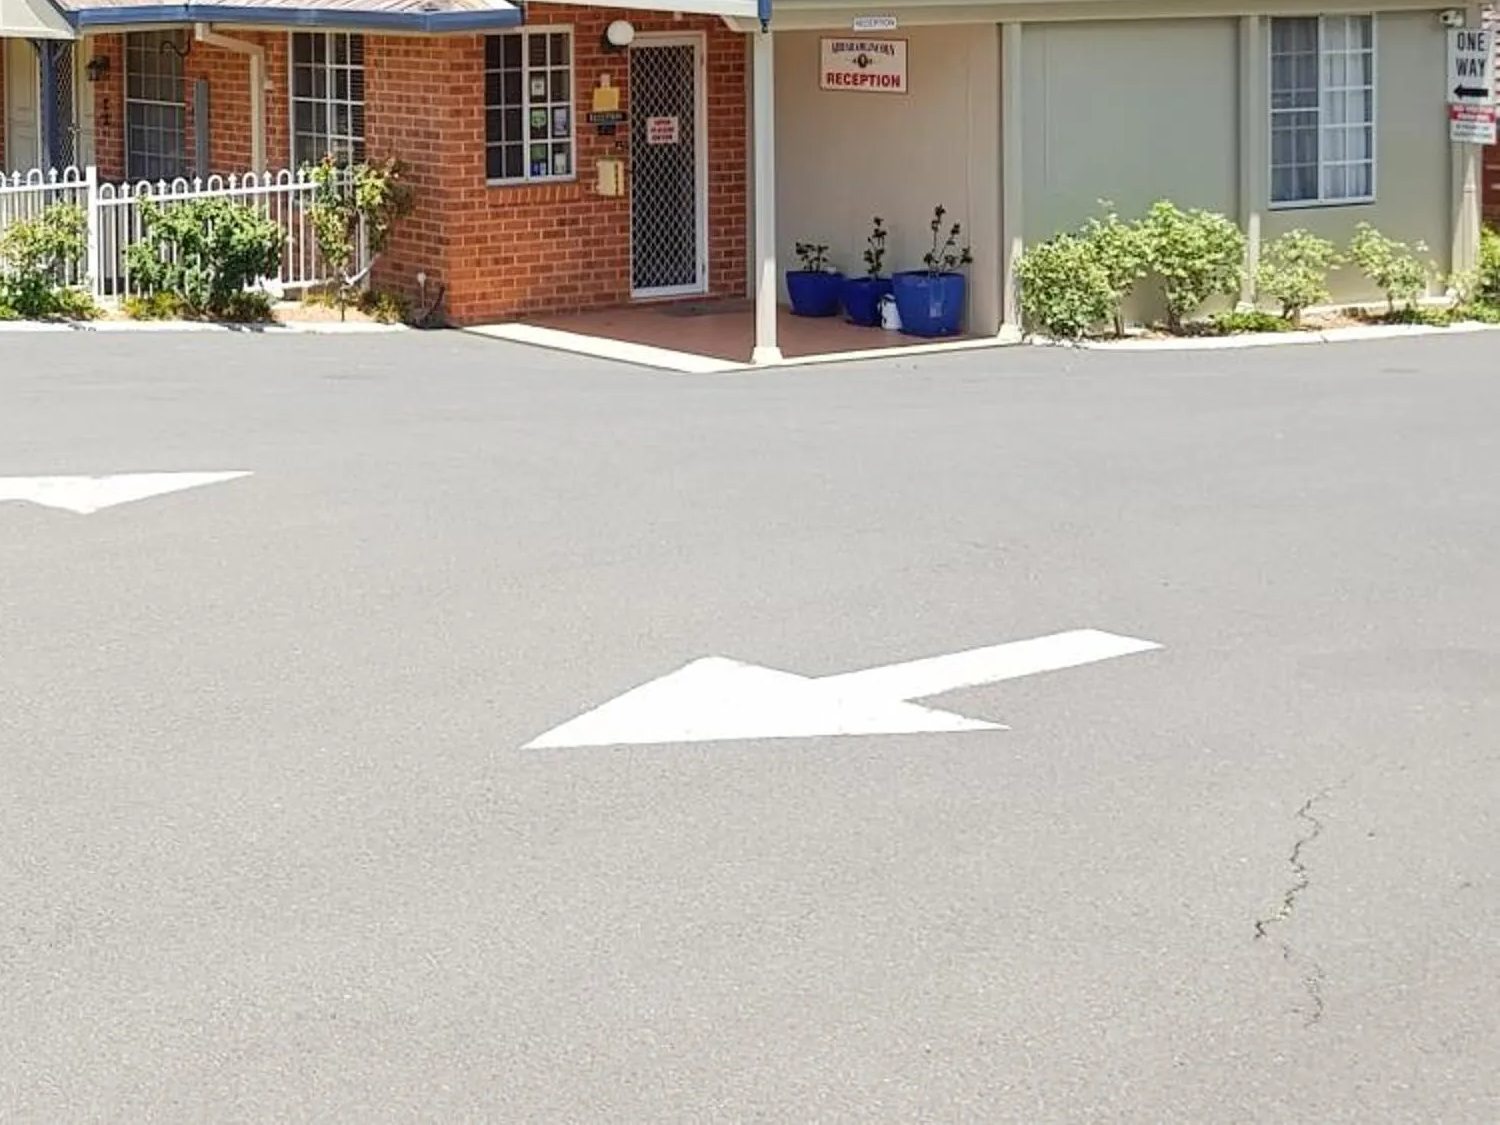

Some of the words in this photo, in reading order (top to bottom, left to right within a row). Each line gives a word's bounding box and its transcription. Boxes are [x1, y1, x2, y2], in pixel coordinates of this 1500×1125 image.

[1457, 32, 1486, 51] ONE
[1456, 58, 1486, 76] WAY
[826, 72, 901, 87] RECEPTION
